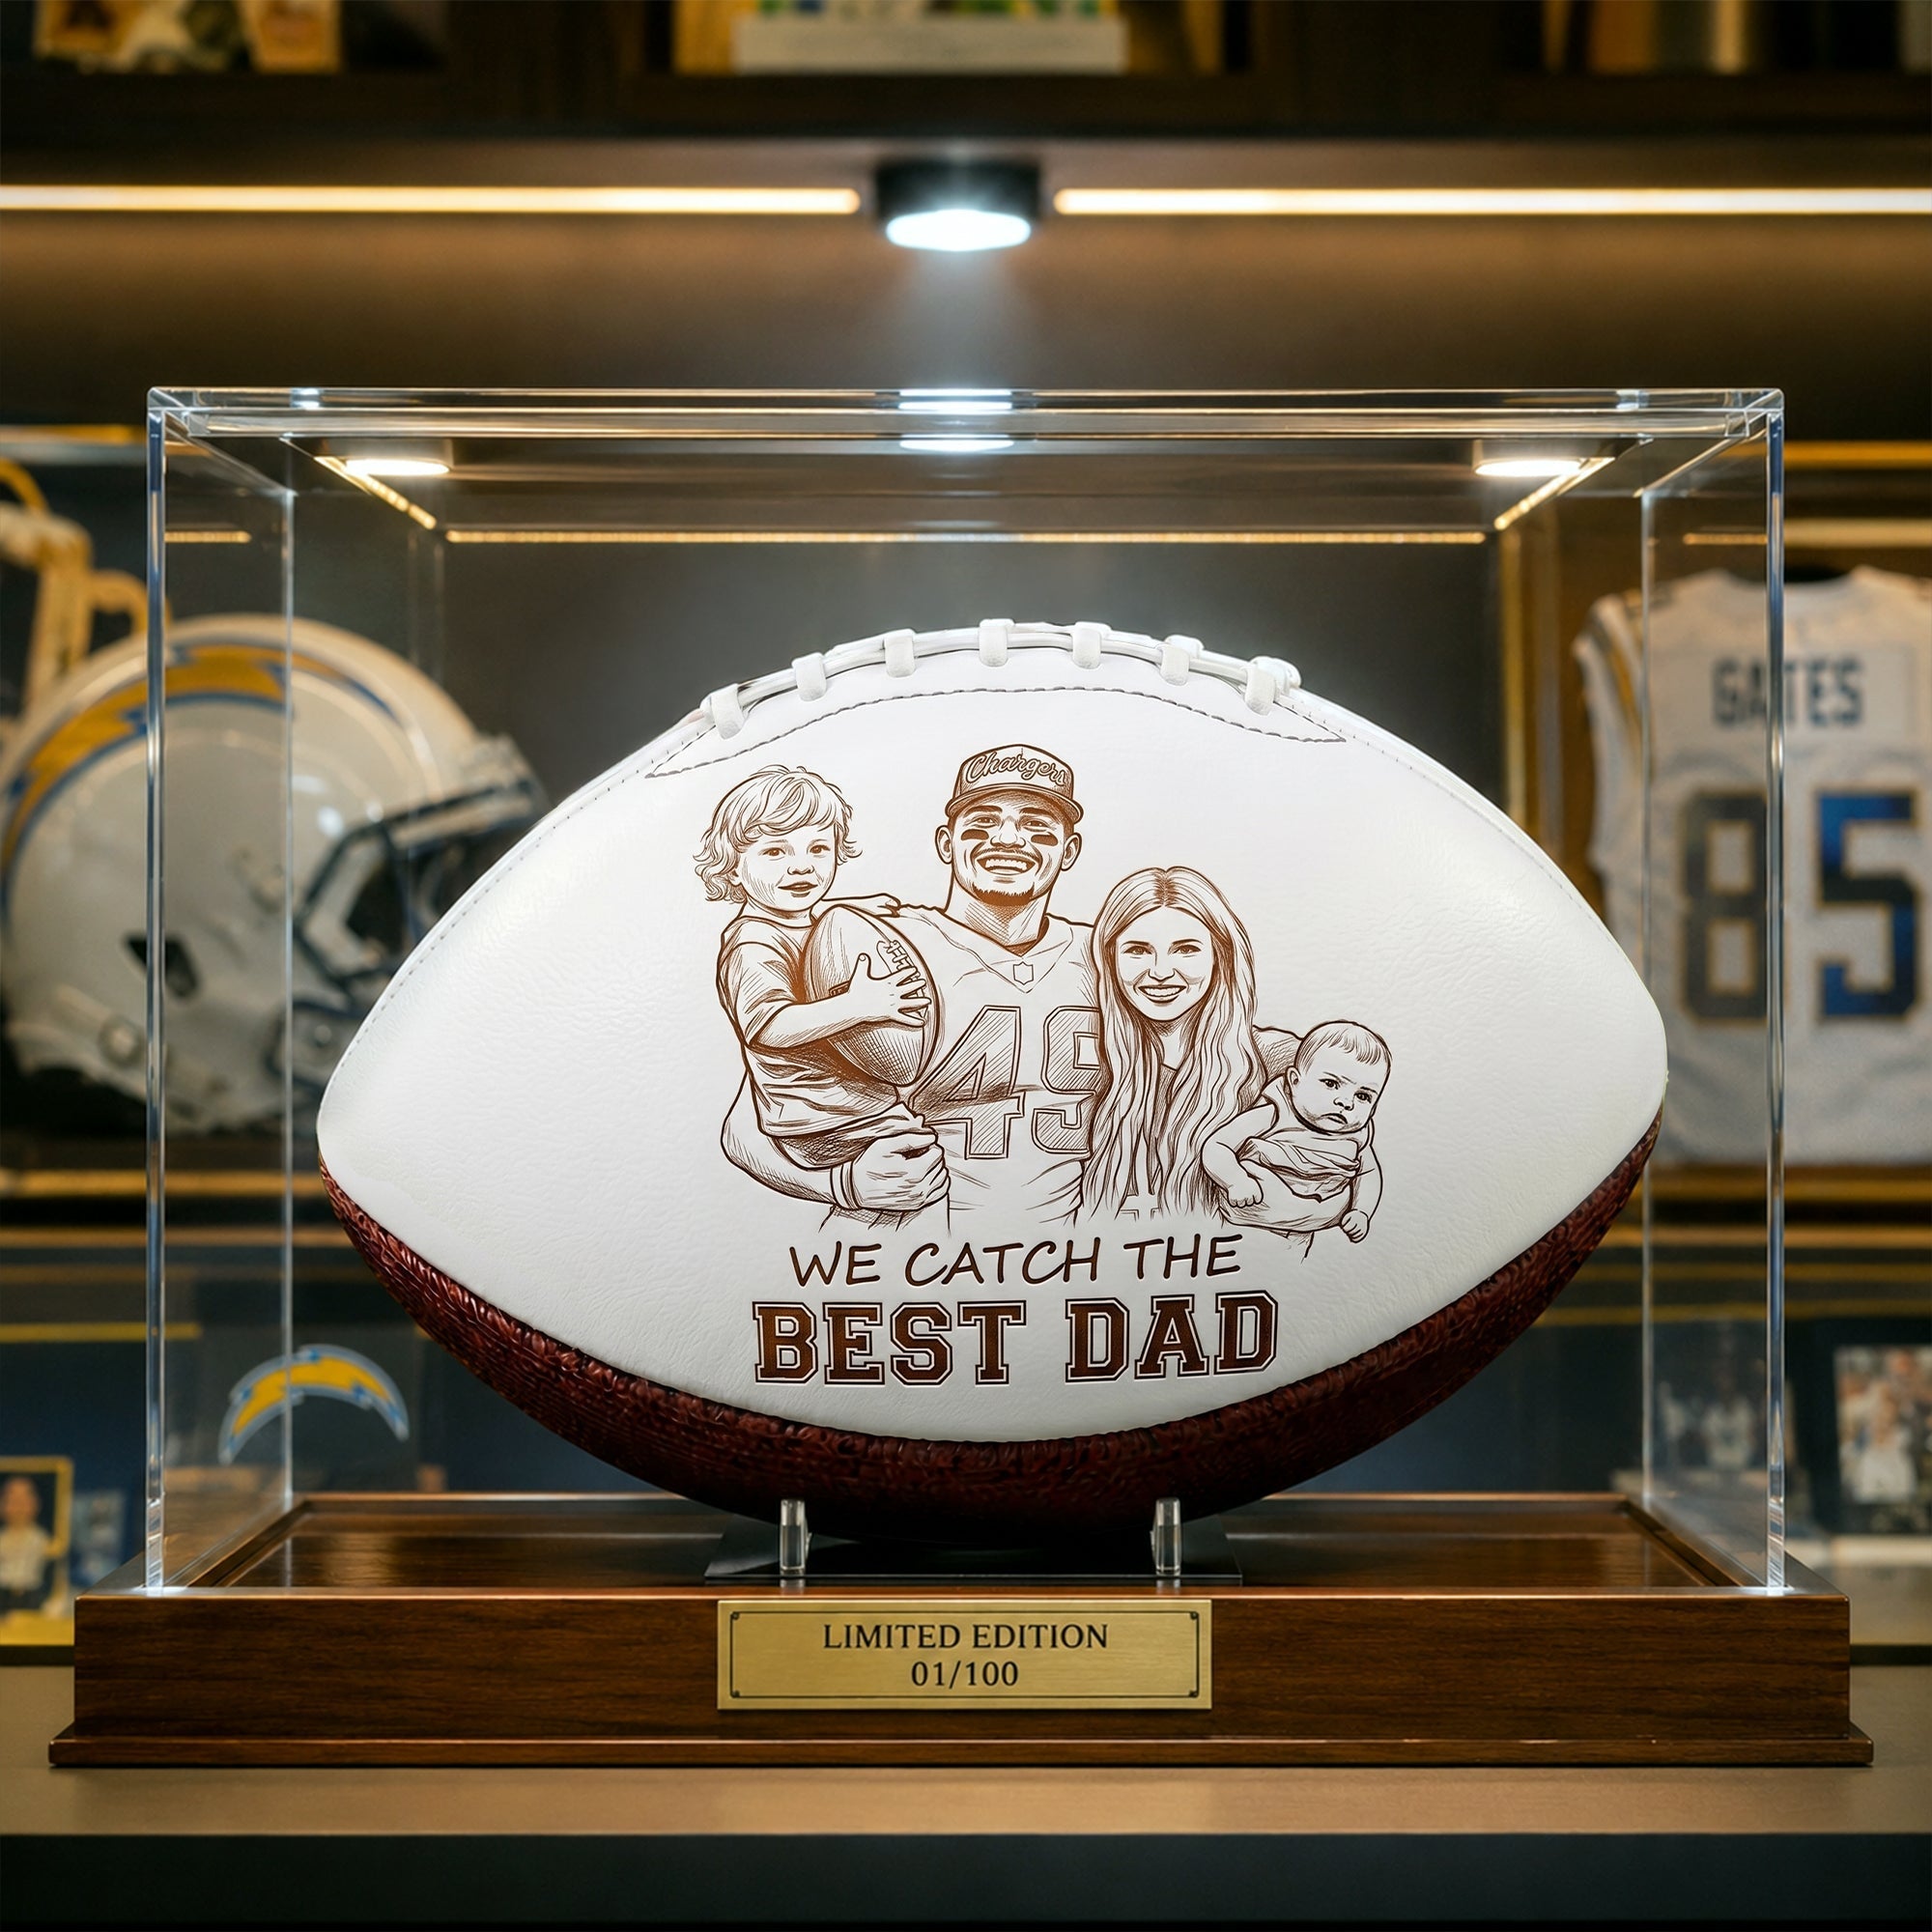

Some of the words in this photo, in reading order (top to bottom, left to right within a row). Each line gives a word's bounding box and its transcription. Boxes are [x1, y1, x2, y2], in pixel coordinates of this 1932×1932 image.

[966, 751, 1067, 786] Chargers
[1679, 786, 1921, 1026] 85
[908, 1005, 1099, 1160] 49
[789, 1240, 883, 1288] WE
[904, 1236, 1101, 1287] CATCH
[1122, 1233, 1243, 1280] THE
[752, 1299, 1027, 1386] BEST
[1065, 1289, 1279, 1383] DAD
[823, 1624, 961, 1649] LIMITED
[972, 1624, 1108, 1649] EDITION
[911, 1660, 1019, 1690] 01/100
